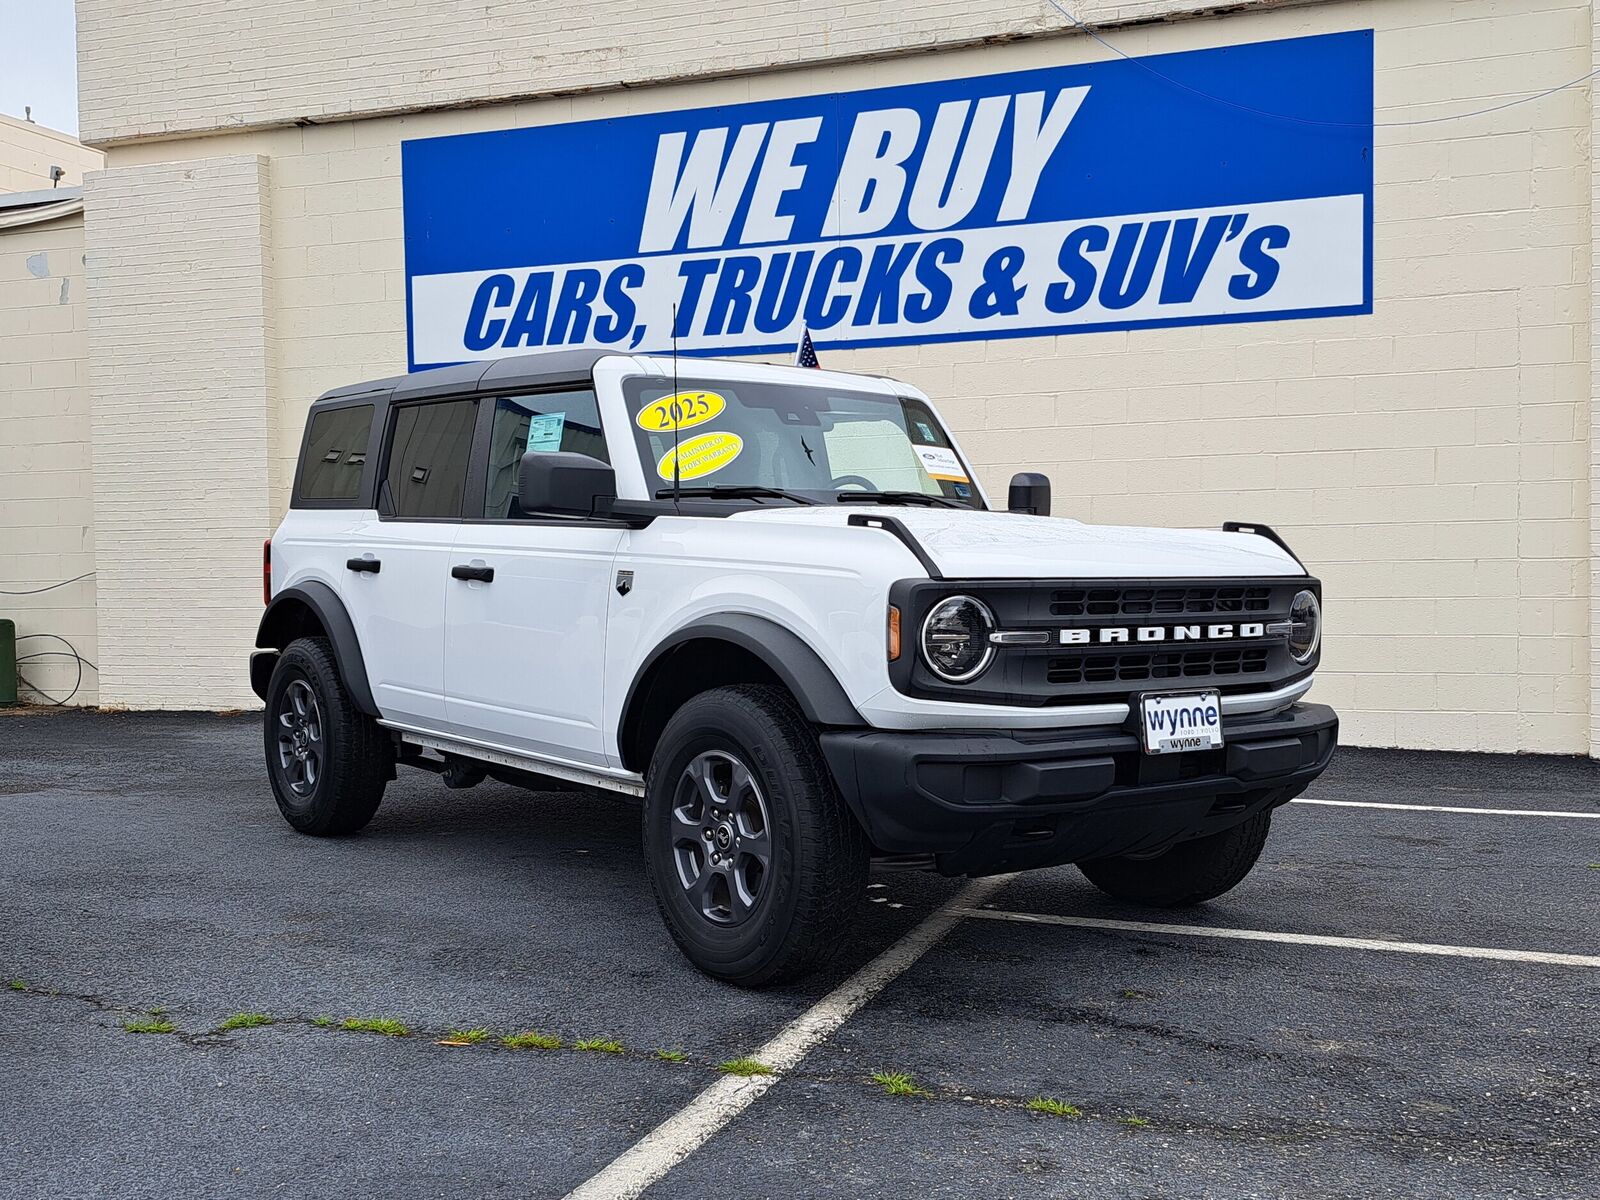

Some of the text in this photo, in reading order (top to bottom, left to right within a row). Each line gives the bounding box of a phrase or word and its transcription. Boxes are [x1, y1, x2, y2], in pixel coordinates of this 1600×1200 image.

[639, 85, 1091, 253] WE BUY
[464, 213, 1290, 350] CARS, TRUCKS & SUV's
[655, 394, 709, 428] 2025
[714, 436, 724, 445] OF
[669, 442, 739, 478] FCTORY WARRANTY
[1060, 623, 1264, 644] BRONCO
[1147, 705, 1218, 736] wynne
[1170, 737, 1201, 750] wynne
